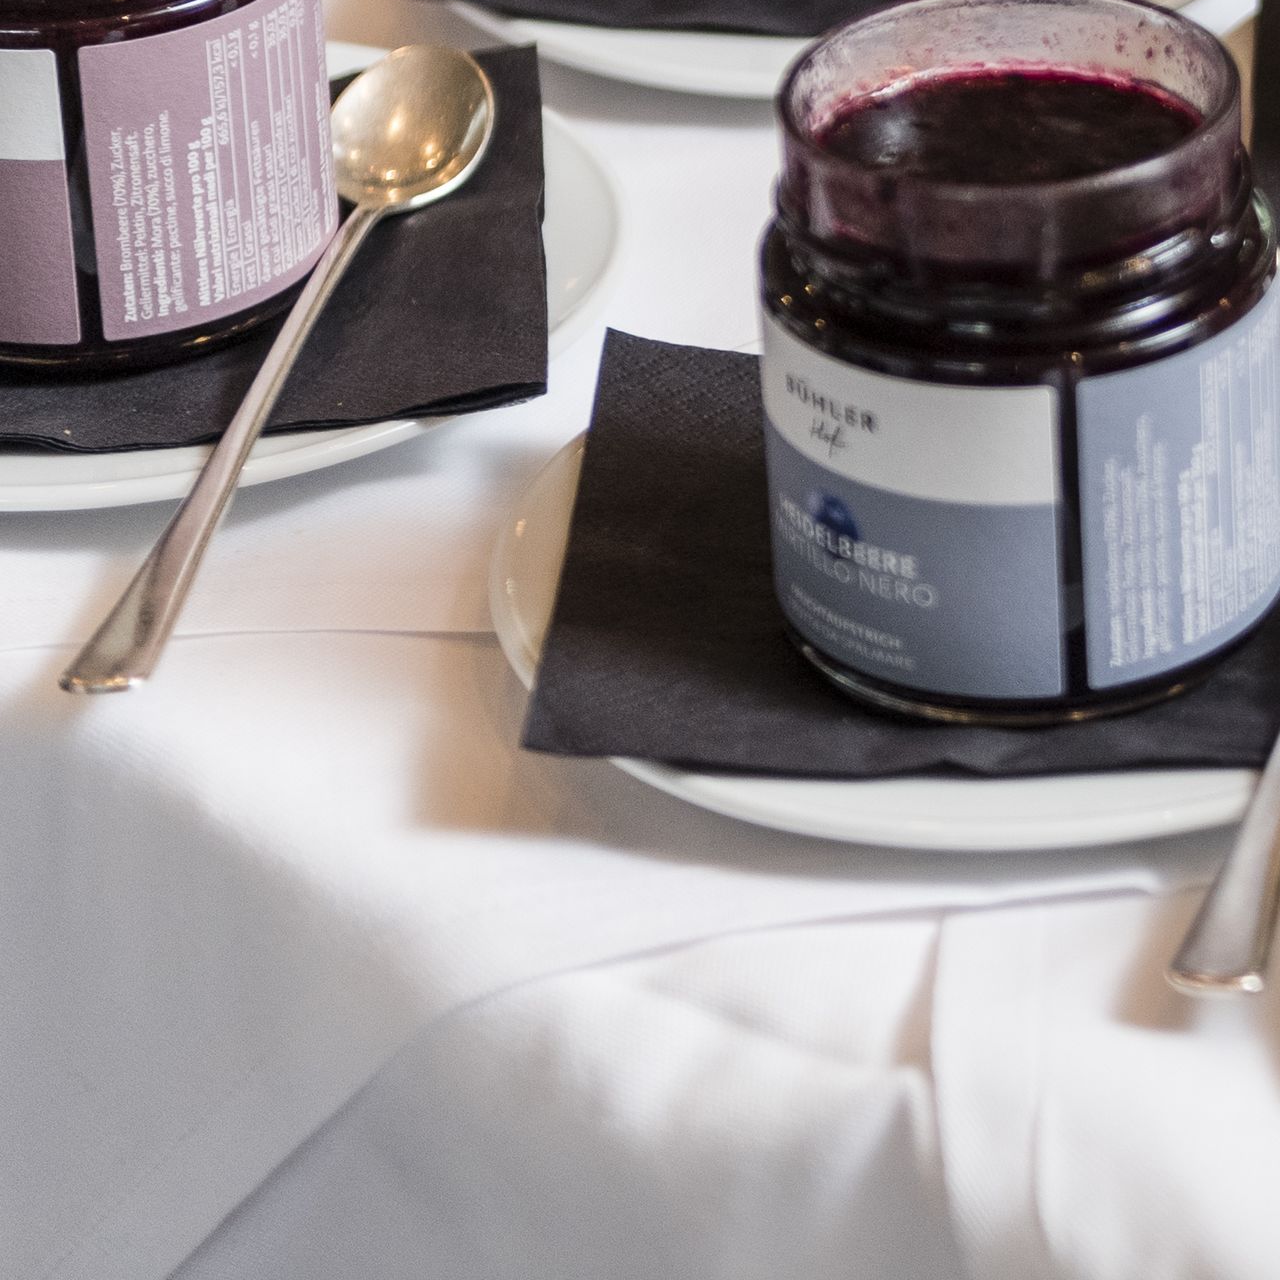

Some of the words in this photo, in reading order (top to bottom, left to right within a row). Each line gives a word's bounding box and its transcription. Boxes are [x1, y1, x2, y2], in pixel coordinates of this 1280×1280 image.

[209, 39, 222, 62] kcal
[109, 127, 124, 170] Zucker,
[142, 124, 157, 179] zucchero,
[157, 110, 171, 154] limone.
[187, 140, 201, 150] g
[200, 128, 213, 150] 100
[124, 131, 143, 206] Zitronensaft.
[159, 156, 171, 166] di
[187, 152, 200, 174] 100
[204, 151, 217, 170] per
[112, 171, 127, 207] (70%),
[145, 181, 160, 216] (70%),
[162, 168, 175, 201] succo
[189, 174, 203, 194] pro
[202, 172, 216, 200] medi
[116, 208, 132, 271] Brombeere
[131, 208, 146, 247] Pektin,
[151, 217, 163, 248] Mora
[166, 202, 182, 248] pectine,
[192, 196, 207, 258] Nährwerte
[206, 202, 222, 267] nutrizionali
[223, 200, 238, 242] Energia
[123, 272, 138, 322] Zutaten:
[134, 248, 154, 320] Geliermittel:
[153, 250, 171, 316] Ingredienti:
[169, 250, 188, 314] gelificante:
[197, 260, 211, 306] Mittlere
[211, 268, 226, 303] Valori
[785, 374, 879, 434] BÜHLER
[859, 570, 936, 609] NERO
